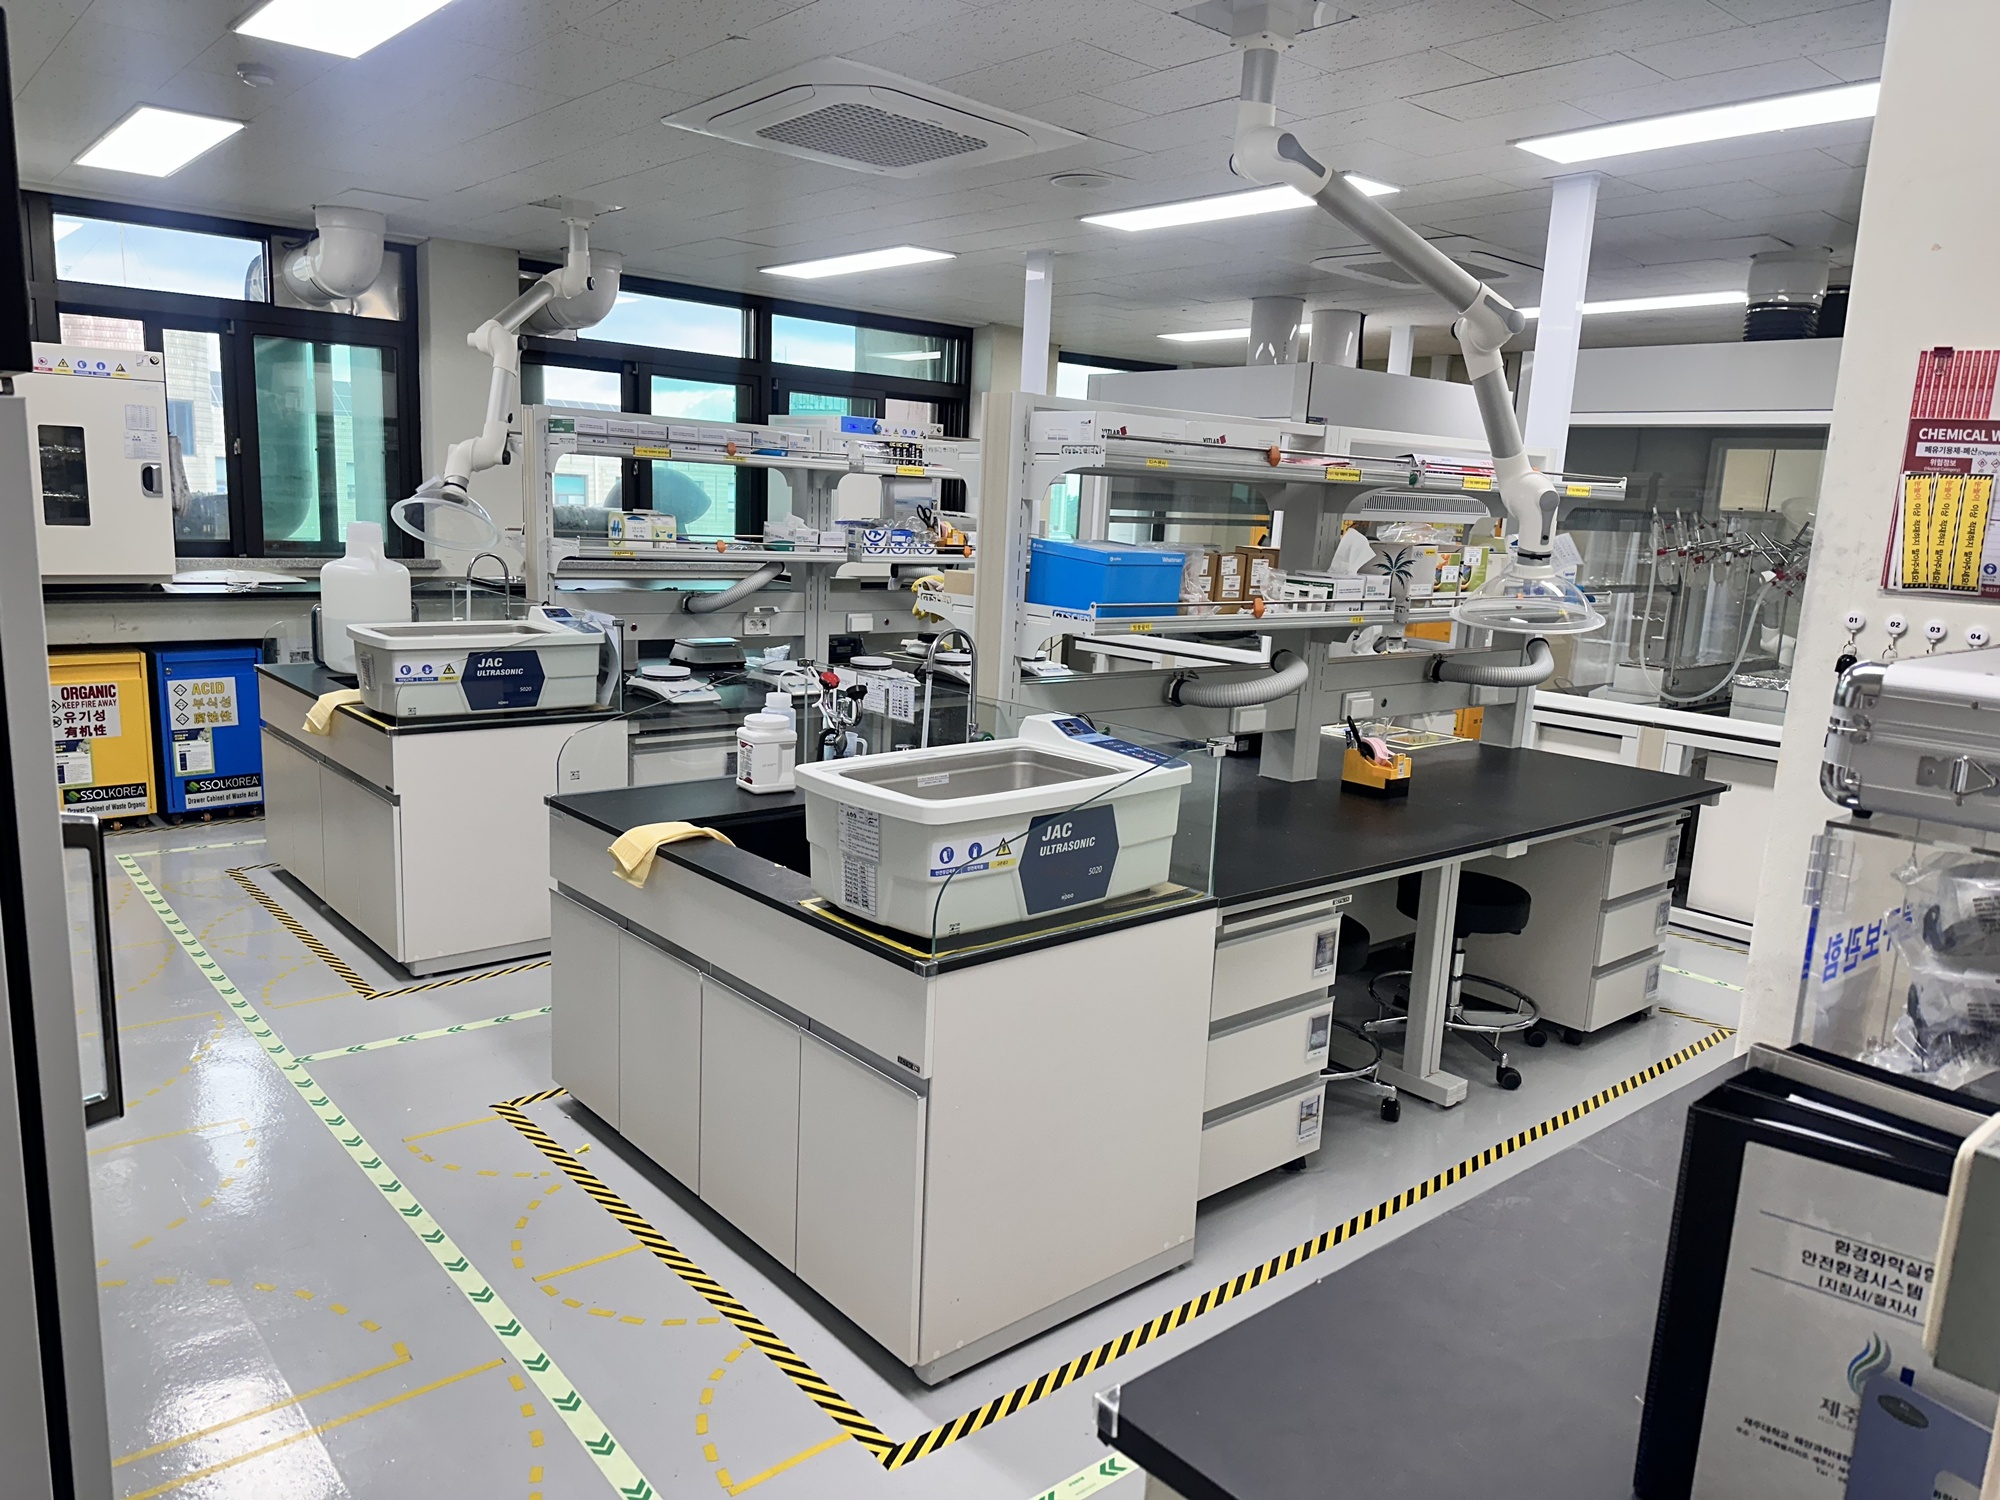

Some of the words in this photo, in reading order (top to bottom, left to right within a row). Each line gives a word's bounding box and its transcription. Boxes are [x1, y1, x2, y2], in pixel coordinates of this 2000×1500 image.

[1918, 427, 1989, 442] CHEMICAL
[1930, 626, 1941, 634] 03
[477, 657, 503, 668] JAC
[476, 668, 524, 677] ULTRASONIC
[61, 684, 117, 701] ORGANIC
[191, 681, 225, 696] ACID
[61, 701, 80, 710] KEEP
[81, 700, 97, 708] FIRE
[97, 699, 117, 708] AWAY
[63, 709, 106, 724] 유기성
[64, 724, 107, 738] 有机性
[200, 776, 258, 791] SSOLKOREA
[80, 786, 145, 801] SSOLKOREA
[187, 797, 205, 805] Drawer
[206, 794, 225, 803] Cabinet
[86, 805, 105, 813] Cabinet
[127, 801, 146, 810] Organic
[1041, 822, 1073, 842] JAC
[1039, 836, 1096, 857] ULTRASONIC
[1088, 865, 1103, 875] 5020
[1802, 1249, 1924, 1301] 안전환경시스템
